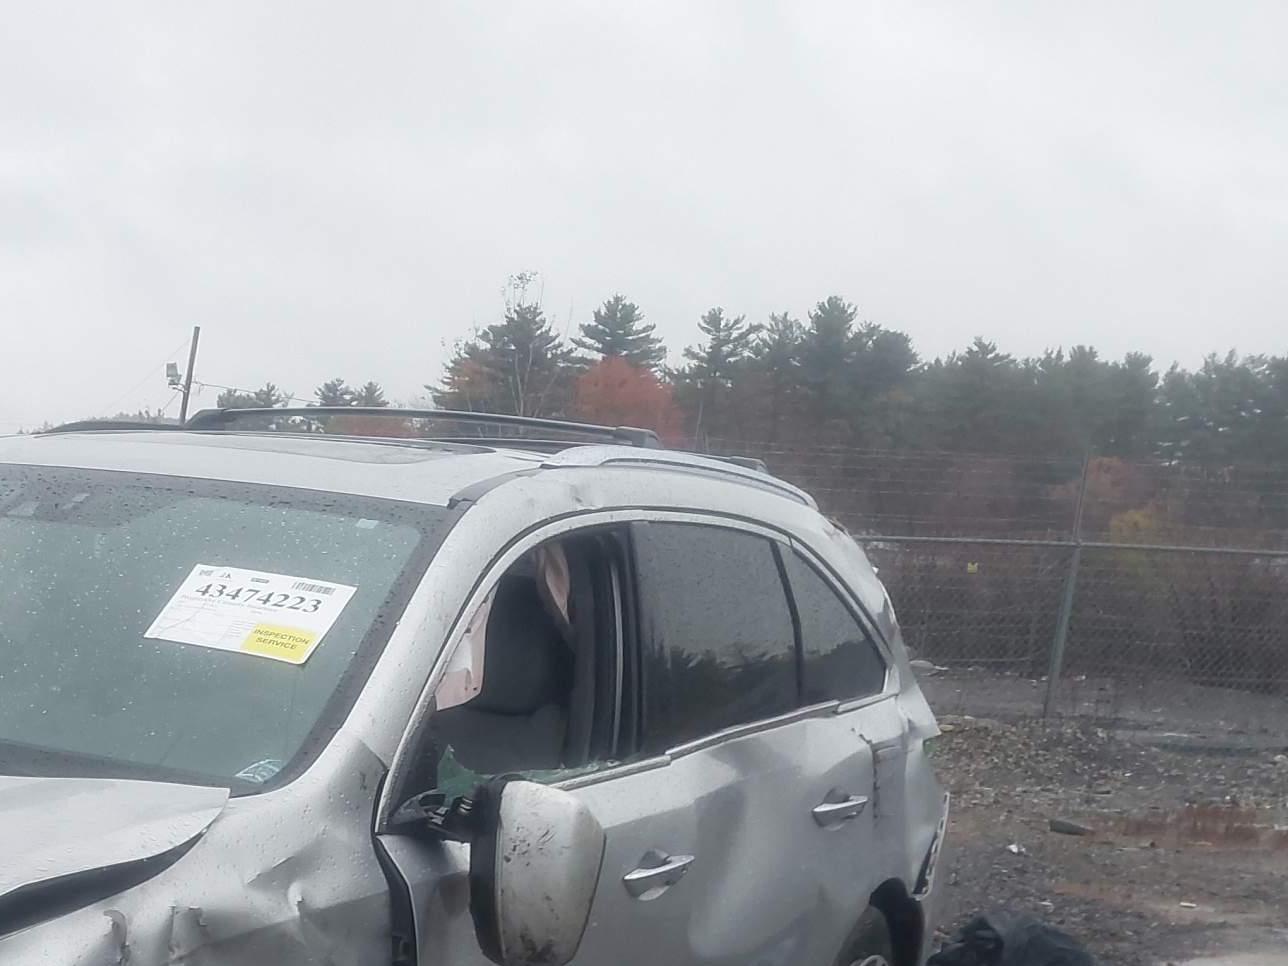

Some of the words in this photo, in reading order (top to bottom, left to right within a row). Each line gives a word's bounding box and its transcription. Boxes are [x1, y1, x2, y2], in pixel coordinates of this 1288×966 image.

[195, 583, 322, 613] 43474223
[253, 628, 310, 645] INSPECTION
[256, 636, 298, 650] SERVICE
